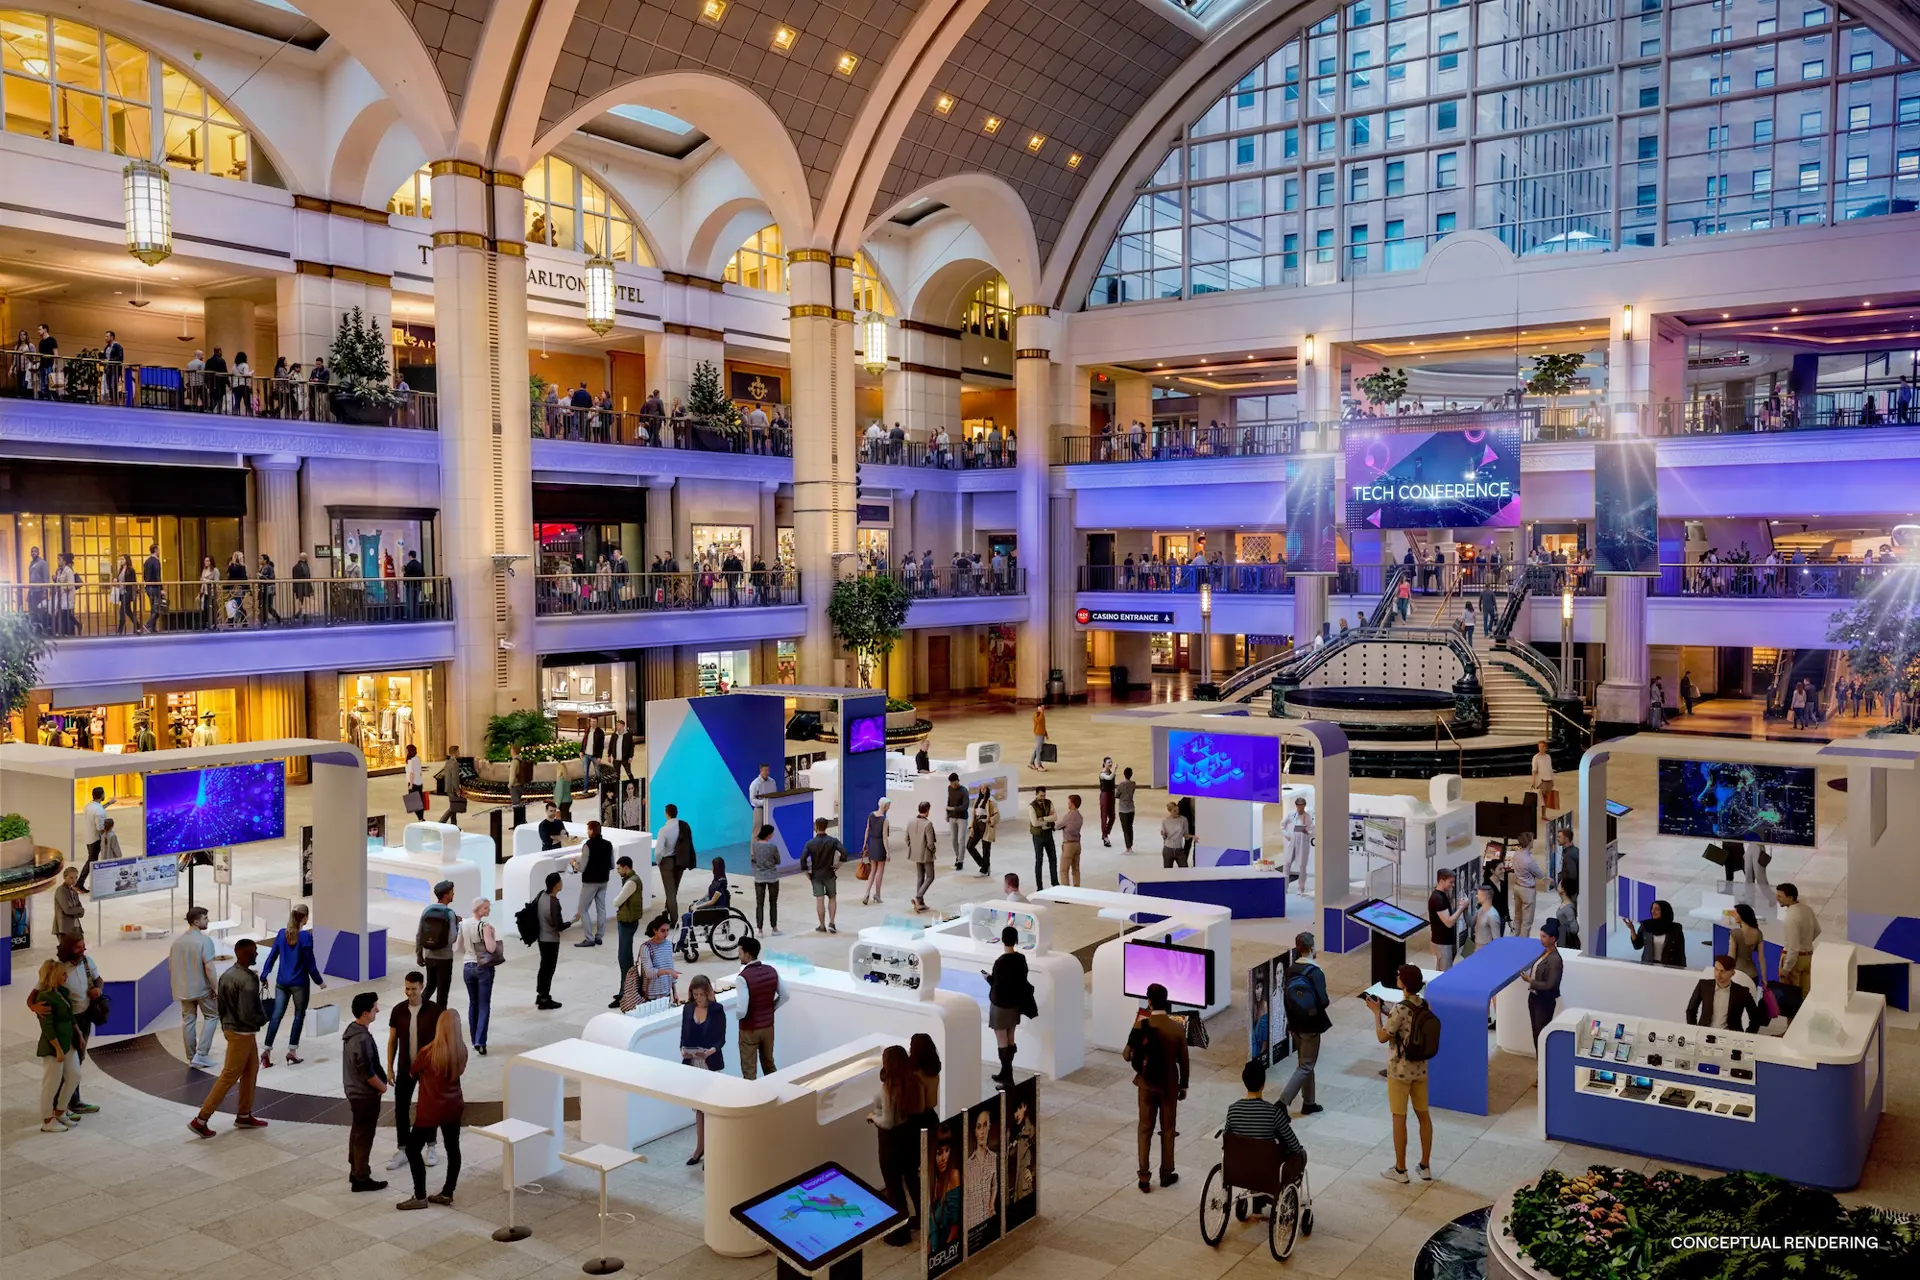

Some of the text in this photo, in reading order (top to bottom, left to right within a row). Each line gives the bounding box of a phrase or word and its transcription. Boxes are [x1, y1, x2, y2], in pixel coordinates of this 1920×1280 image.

[527, 268, 586, 292] ARLTON
[1352, 482, 1510, 501] TECH CONFERENCE
[928, 1241, 960, 1270] DISPLAY
